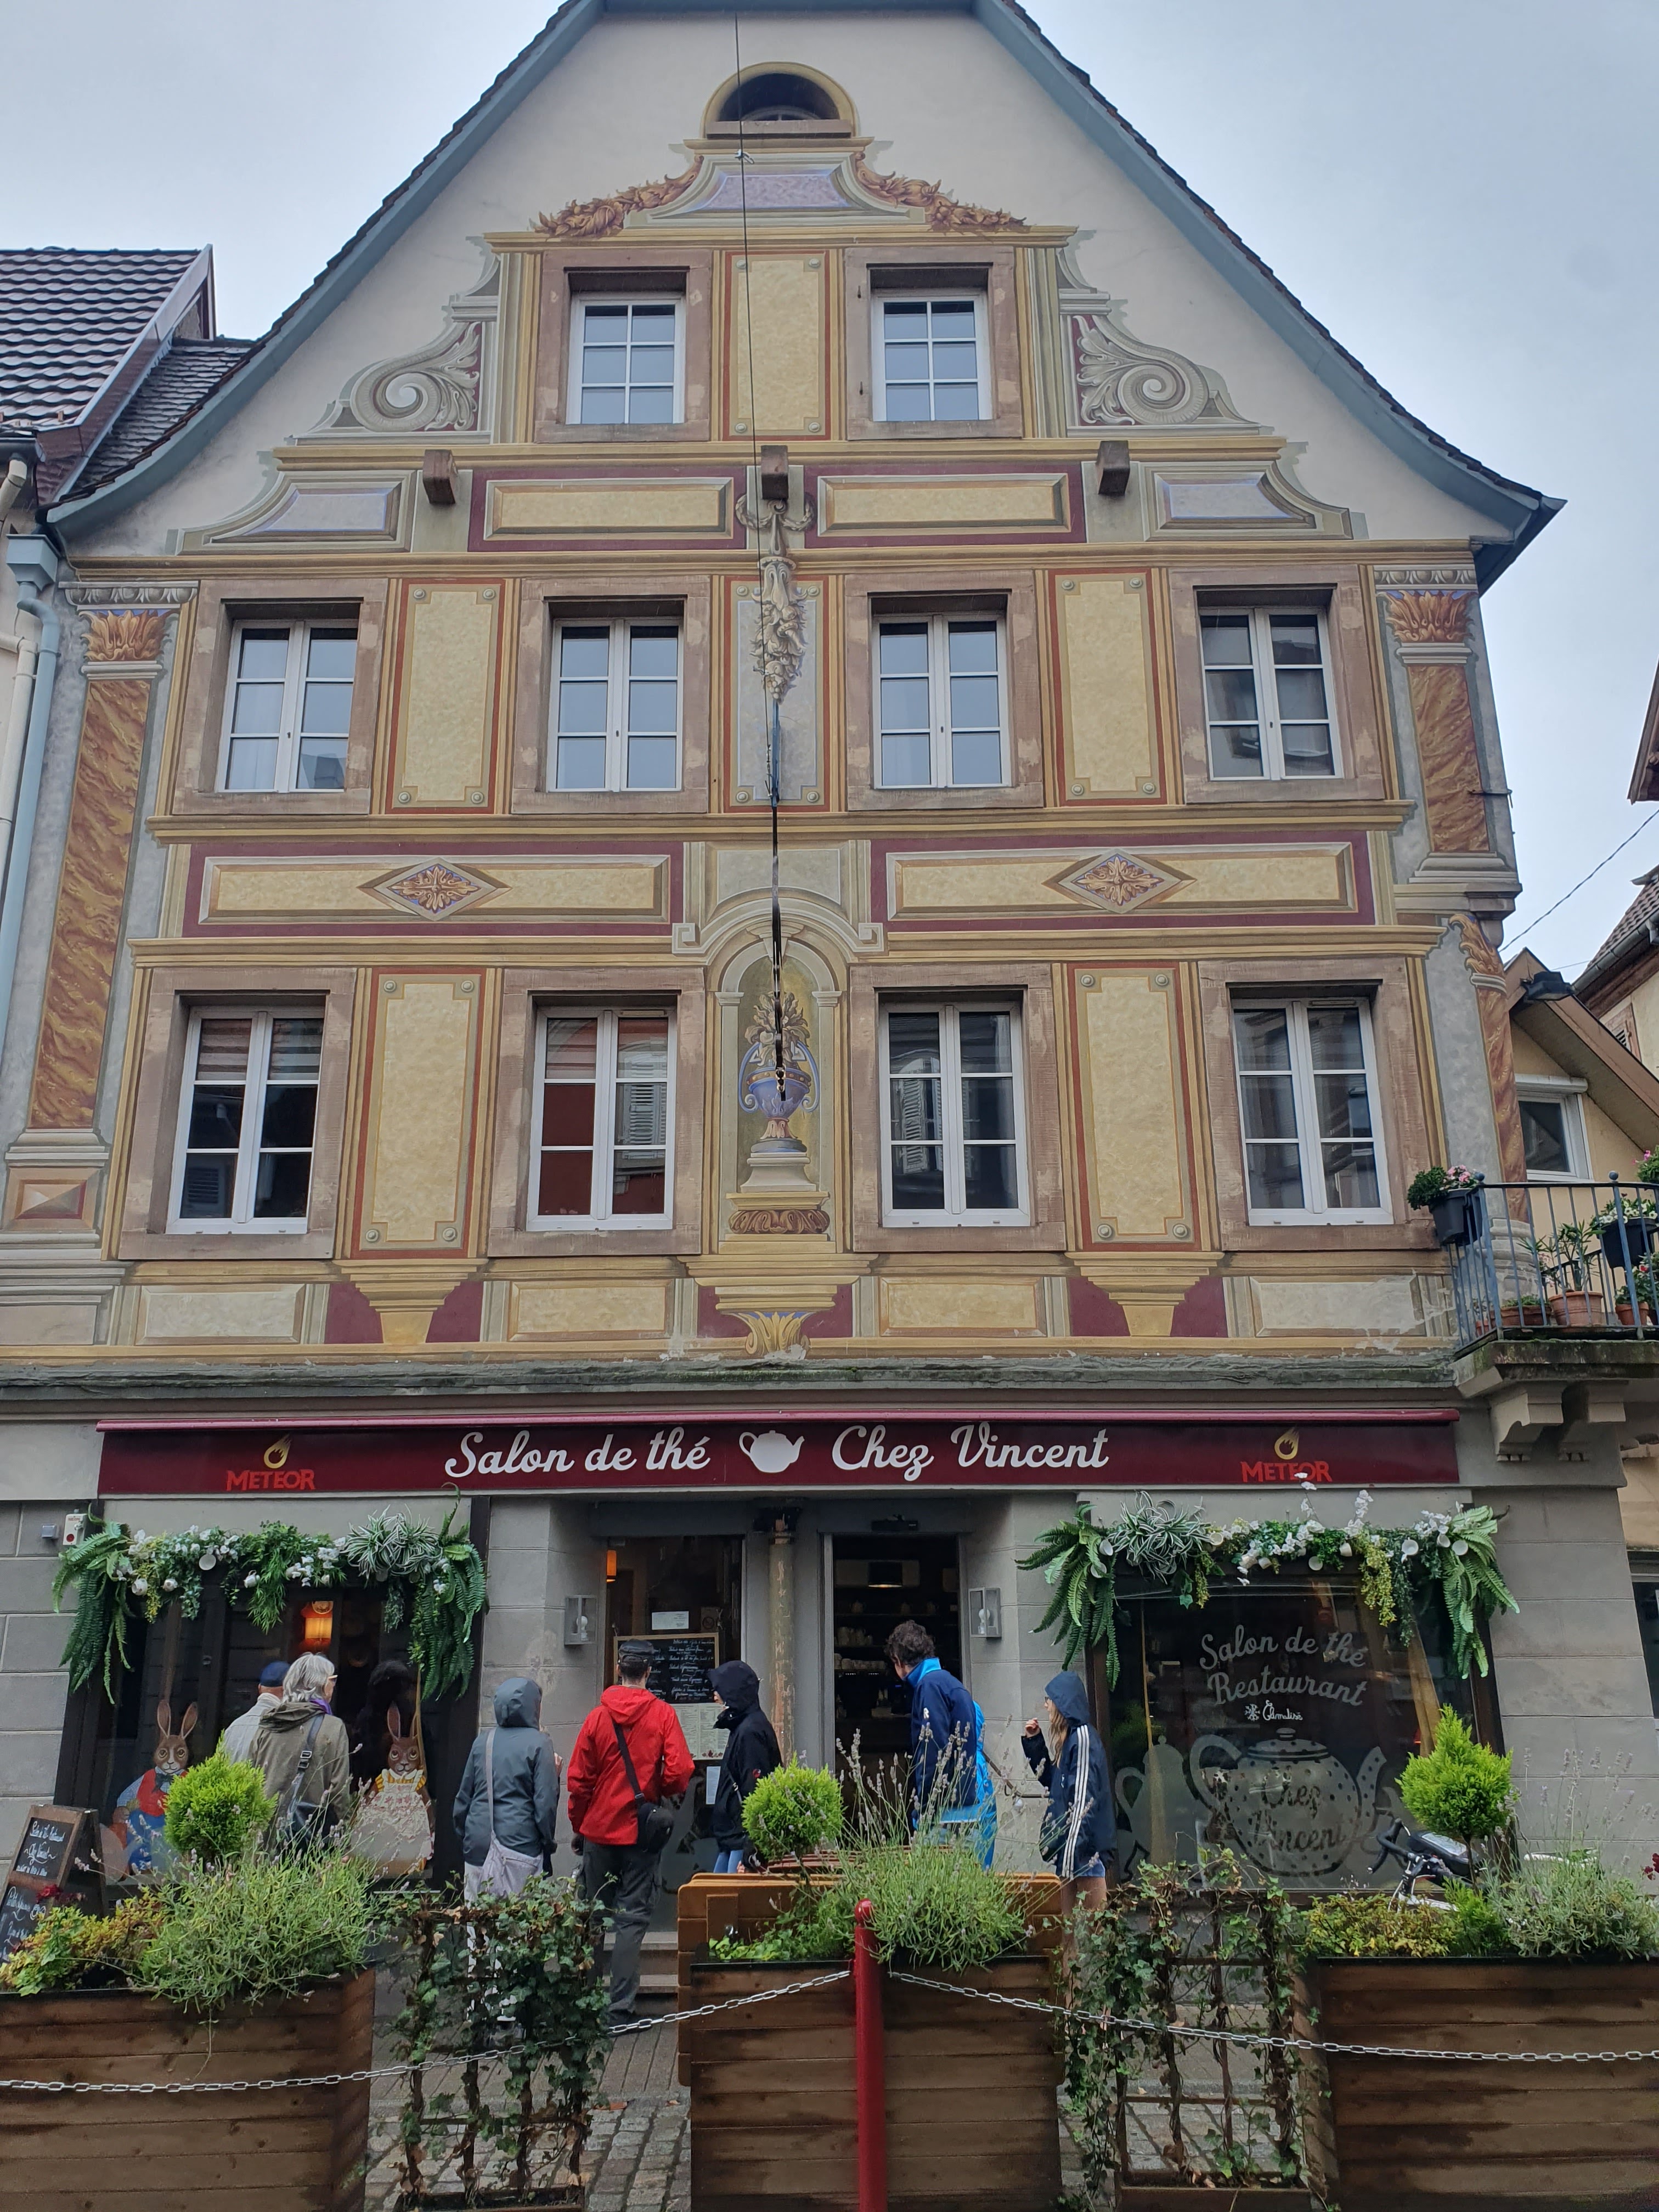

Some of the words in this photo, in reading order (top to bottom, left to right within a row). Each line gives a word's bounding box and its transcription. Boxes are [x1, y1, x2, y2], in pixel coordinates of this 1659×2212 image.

[445, 1430, 574, 1477] Salon
[585, 1434, 637, 1471] de
[646, 1426, 710, 1470] thé
[832, 1425, 934, 1481] Chez
[950, 1420, 1109, 1468] Vincent
[1240, 1460, 1333, 1482] METEOR
[226, 1469, 316, 1491] METEOR
[1199, 1624, 1279, 1669] Salon
[1285, 1626, 1319, 1654] de
[1325, 1632, 1368, 1667] thé
[1207, 1665, 1368, 1706] Restaurant
